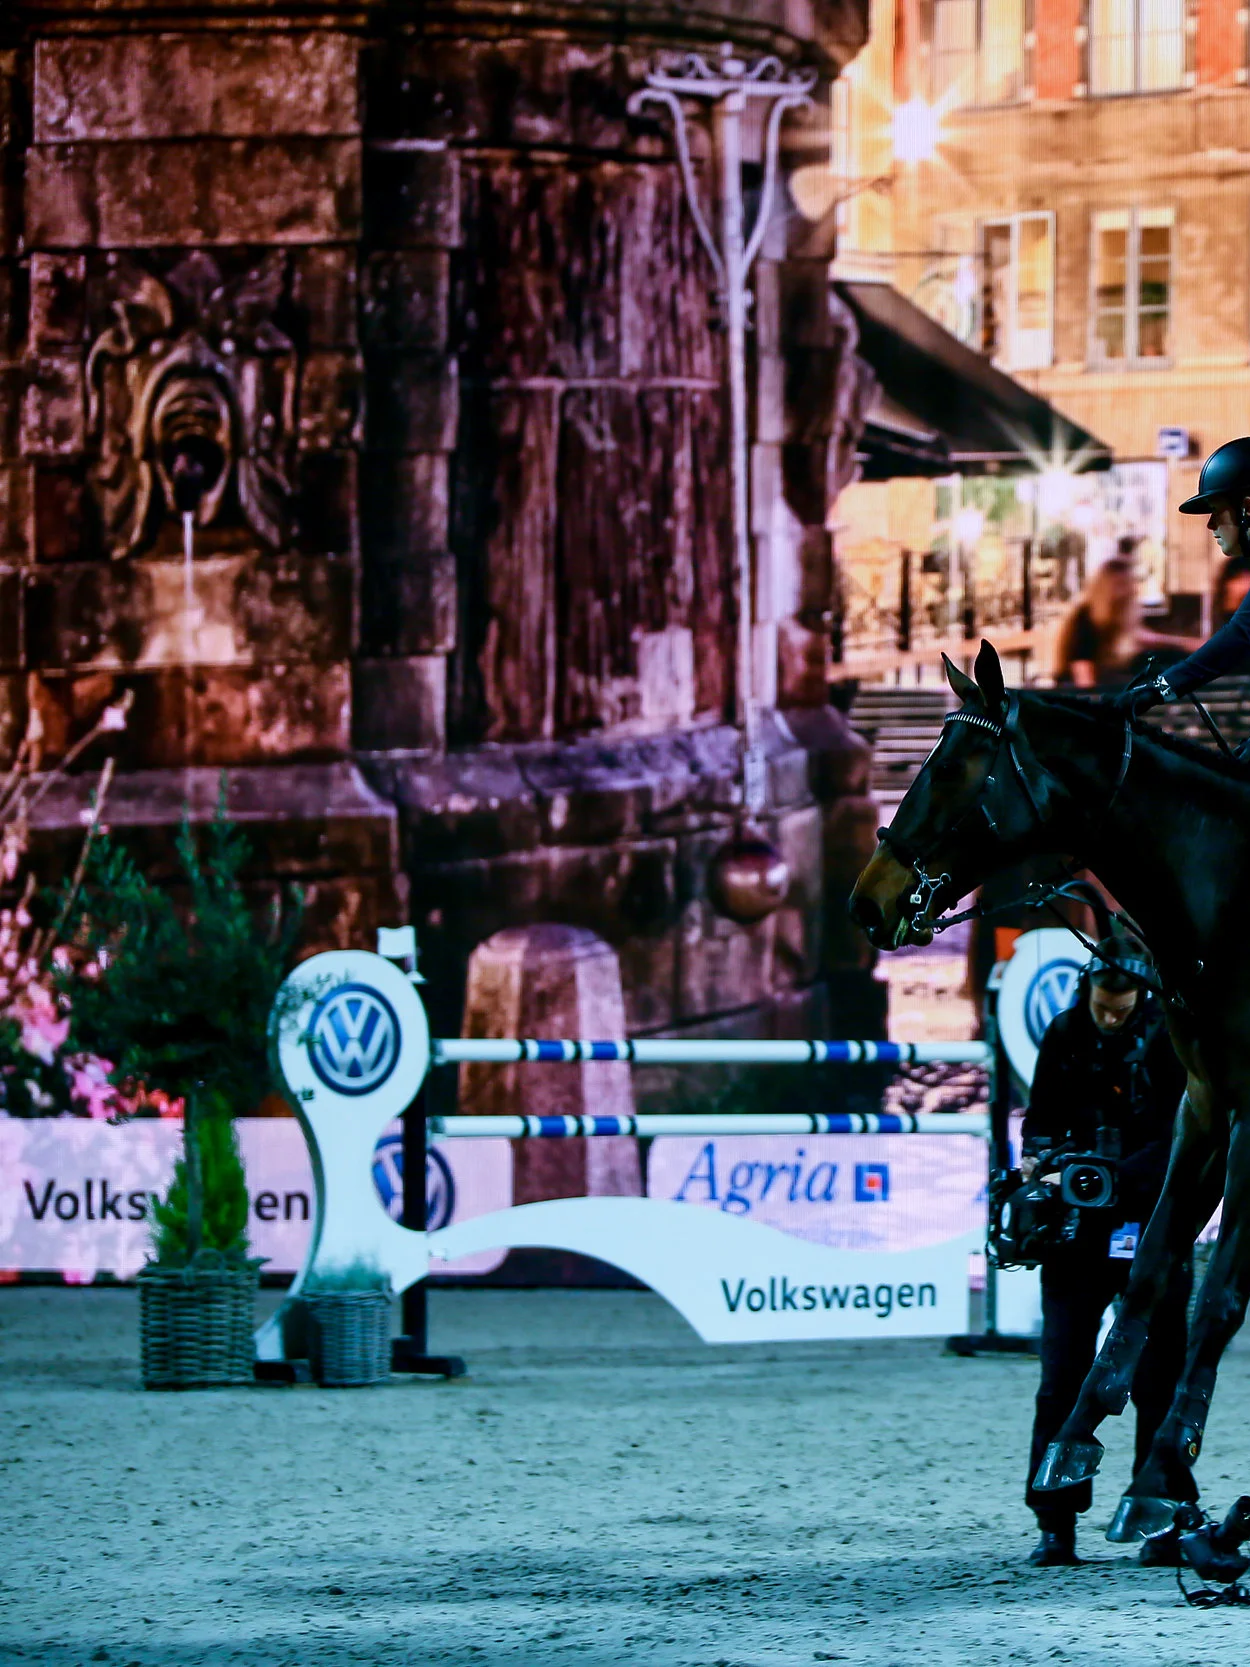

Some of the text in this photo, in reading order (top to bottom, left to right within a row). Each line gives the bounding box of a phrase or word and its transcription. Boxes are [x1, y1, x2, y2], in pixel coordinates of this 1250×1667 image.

[673, 1141, 839, 1214] Agria
[24, 1179, 309, 1221] Volksen
[721, 1276, 937, 1319] Volkswagen
